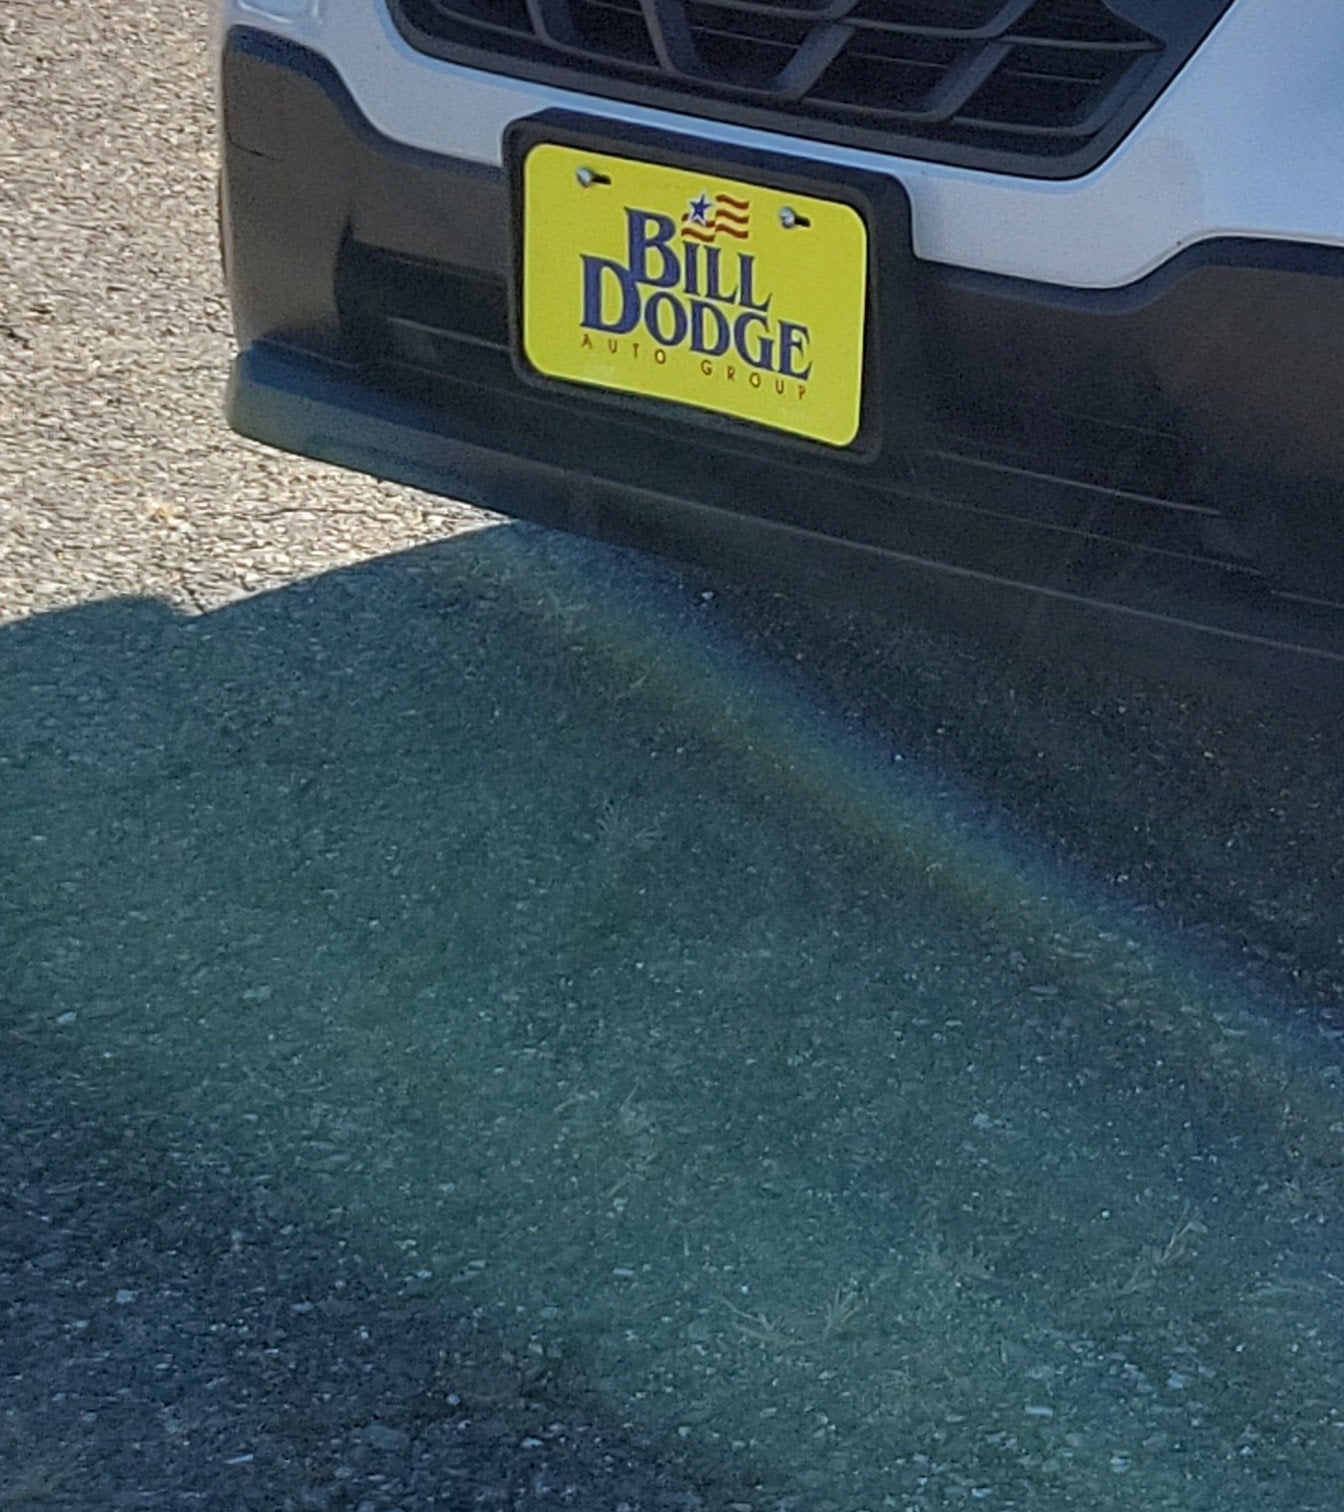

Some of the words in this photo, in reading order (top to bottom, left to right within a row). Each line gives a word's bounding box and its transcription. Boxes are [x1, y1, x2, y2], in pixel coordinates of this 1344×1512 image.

[624, 206, 773, 313] BILL
[579, 254, 813, 381] DODGE
[580, 333, 667, 366] AUTO
[700, 359, 807, 400] GROUP
